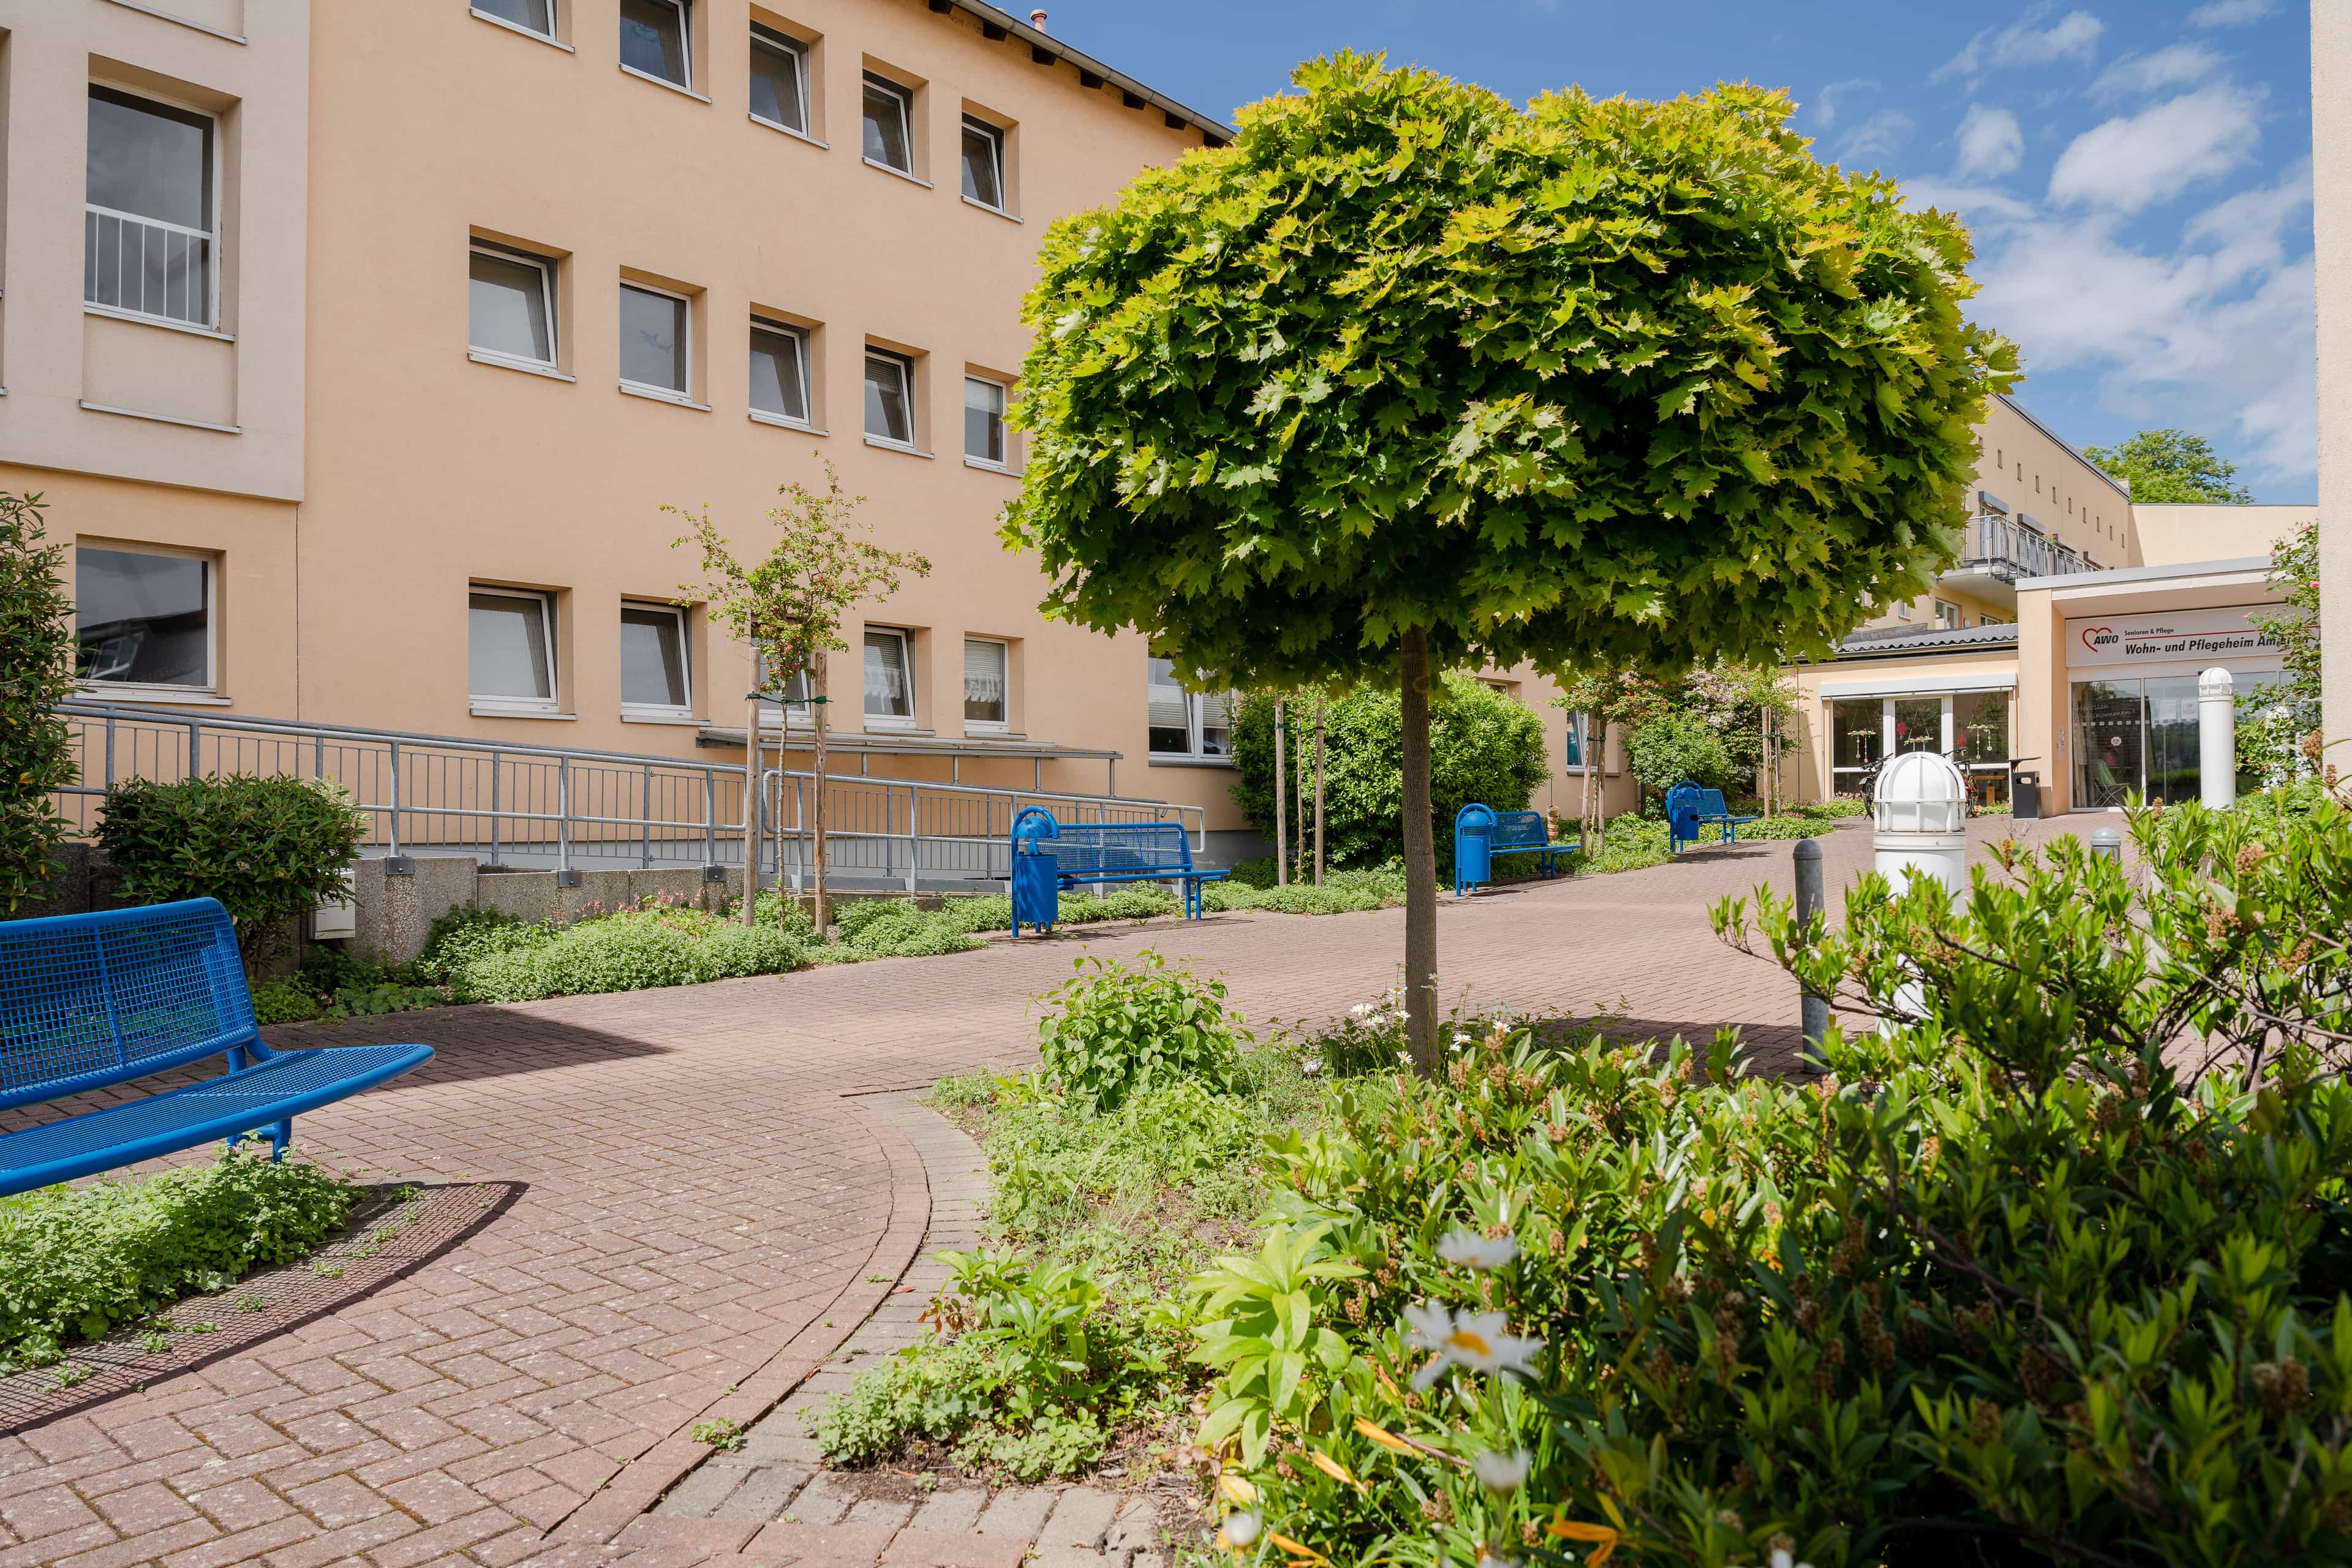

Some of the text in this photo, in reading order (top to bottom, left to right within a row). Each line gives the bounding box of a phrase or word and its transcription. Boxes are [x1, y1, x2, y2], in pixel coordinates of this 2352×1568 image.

[2094, 635, 2119, 645] AWO
[2125, 643, 2162, 655] Wohn-
[2165, 639, 2186, 652] und
[2188, 637, 2254, 652] Pflegeheim
[2256, 636, 2276, 647] Am
